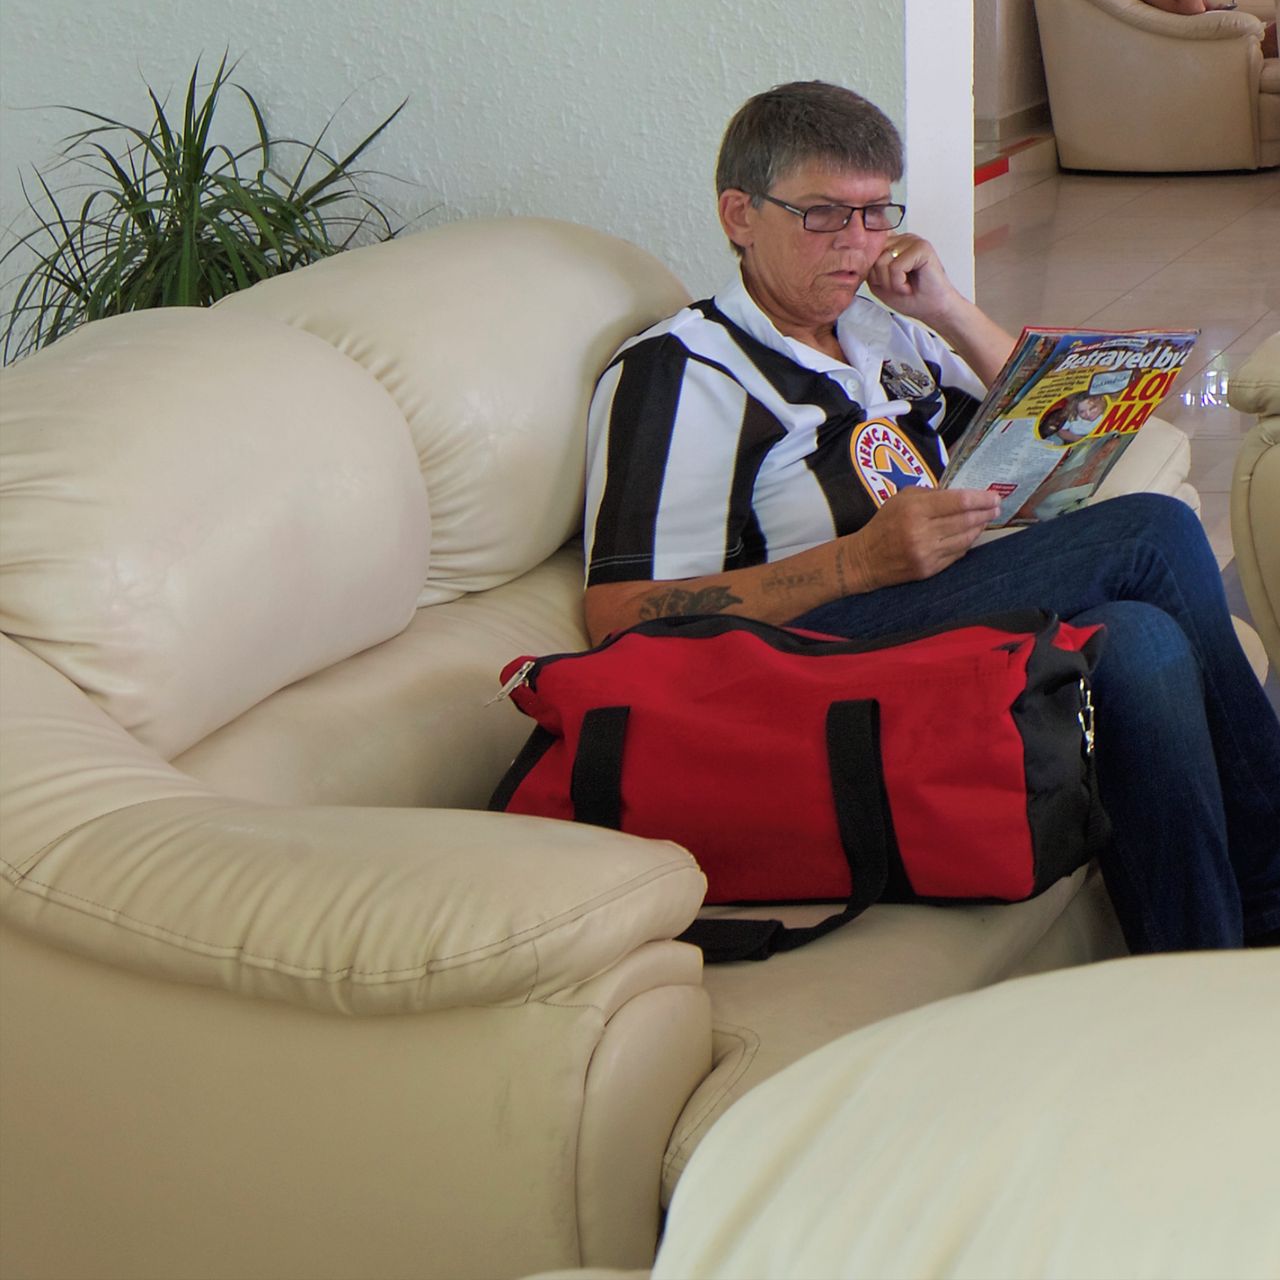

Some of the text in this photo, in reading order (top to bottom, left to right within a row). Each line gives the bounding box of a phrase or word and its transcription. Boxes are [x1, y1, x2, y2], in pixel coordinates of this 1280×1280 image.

[1055, 346, 1162, 373] Betrayed
[1152, 345, 1186, 374] by
[860, 427, 924, 476] NEWCASTLE
